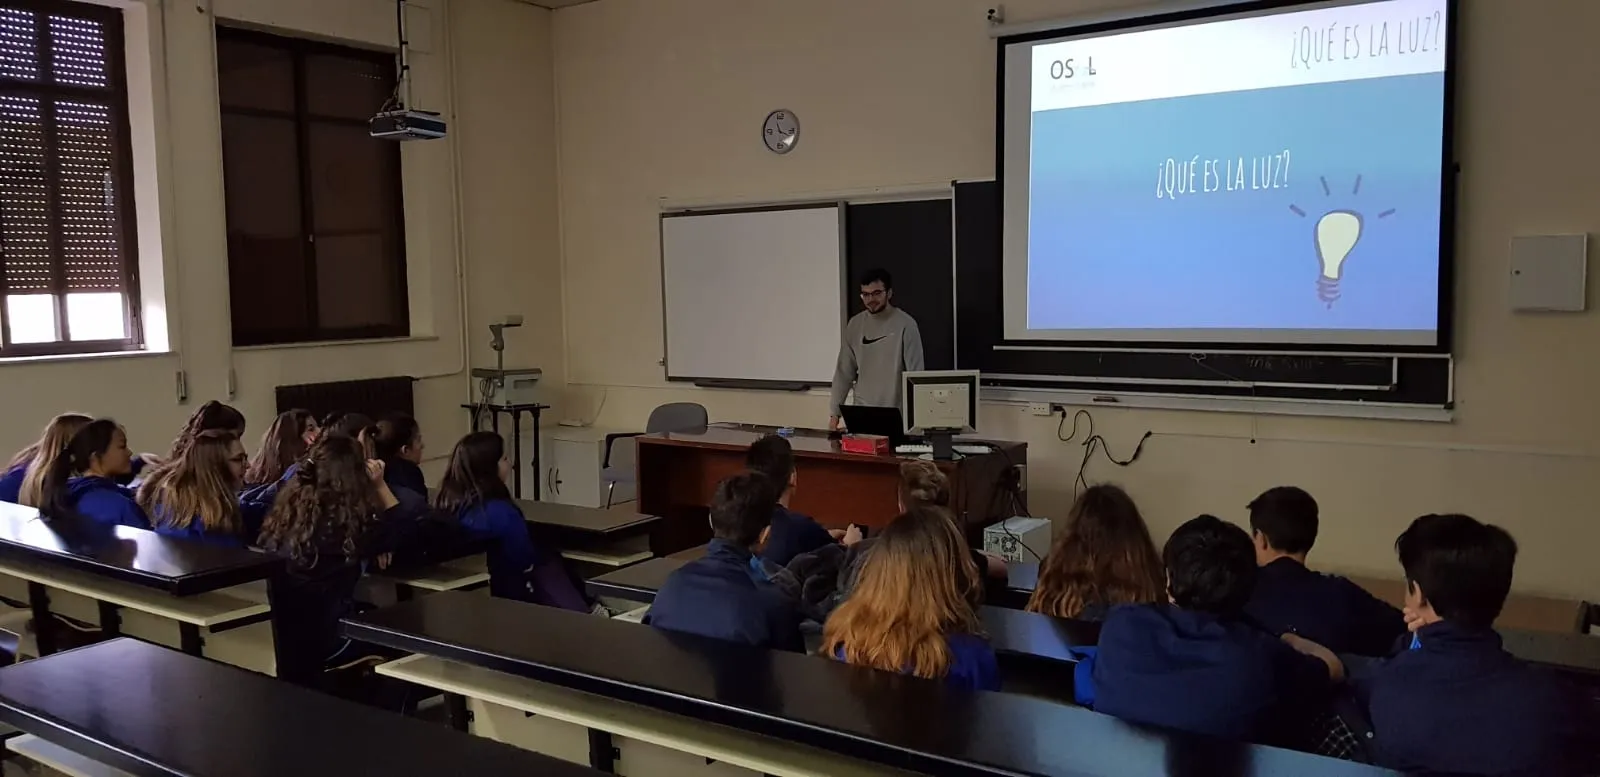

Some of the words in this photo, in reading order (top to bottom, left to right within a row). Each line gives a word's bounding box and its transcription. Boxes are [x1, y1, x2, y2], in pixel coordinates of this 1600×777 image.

[1291, 22, 1337, 70] ¿QUÉ
[1343, 24, 1360, 60] ES
[1369, 21, 1389, 58] LA
[1398, 10, 1441, 55] LUZ?
[1156, 154, 1200, 200] ¿QUÉ
[1203, 159, 1219, 193] ES
[1226, 157, 1245, 191] LA
[1252, 149, 1290, 190] LUZ?
